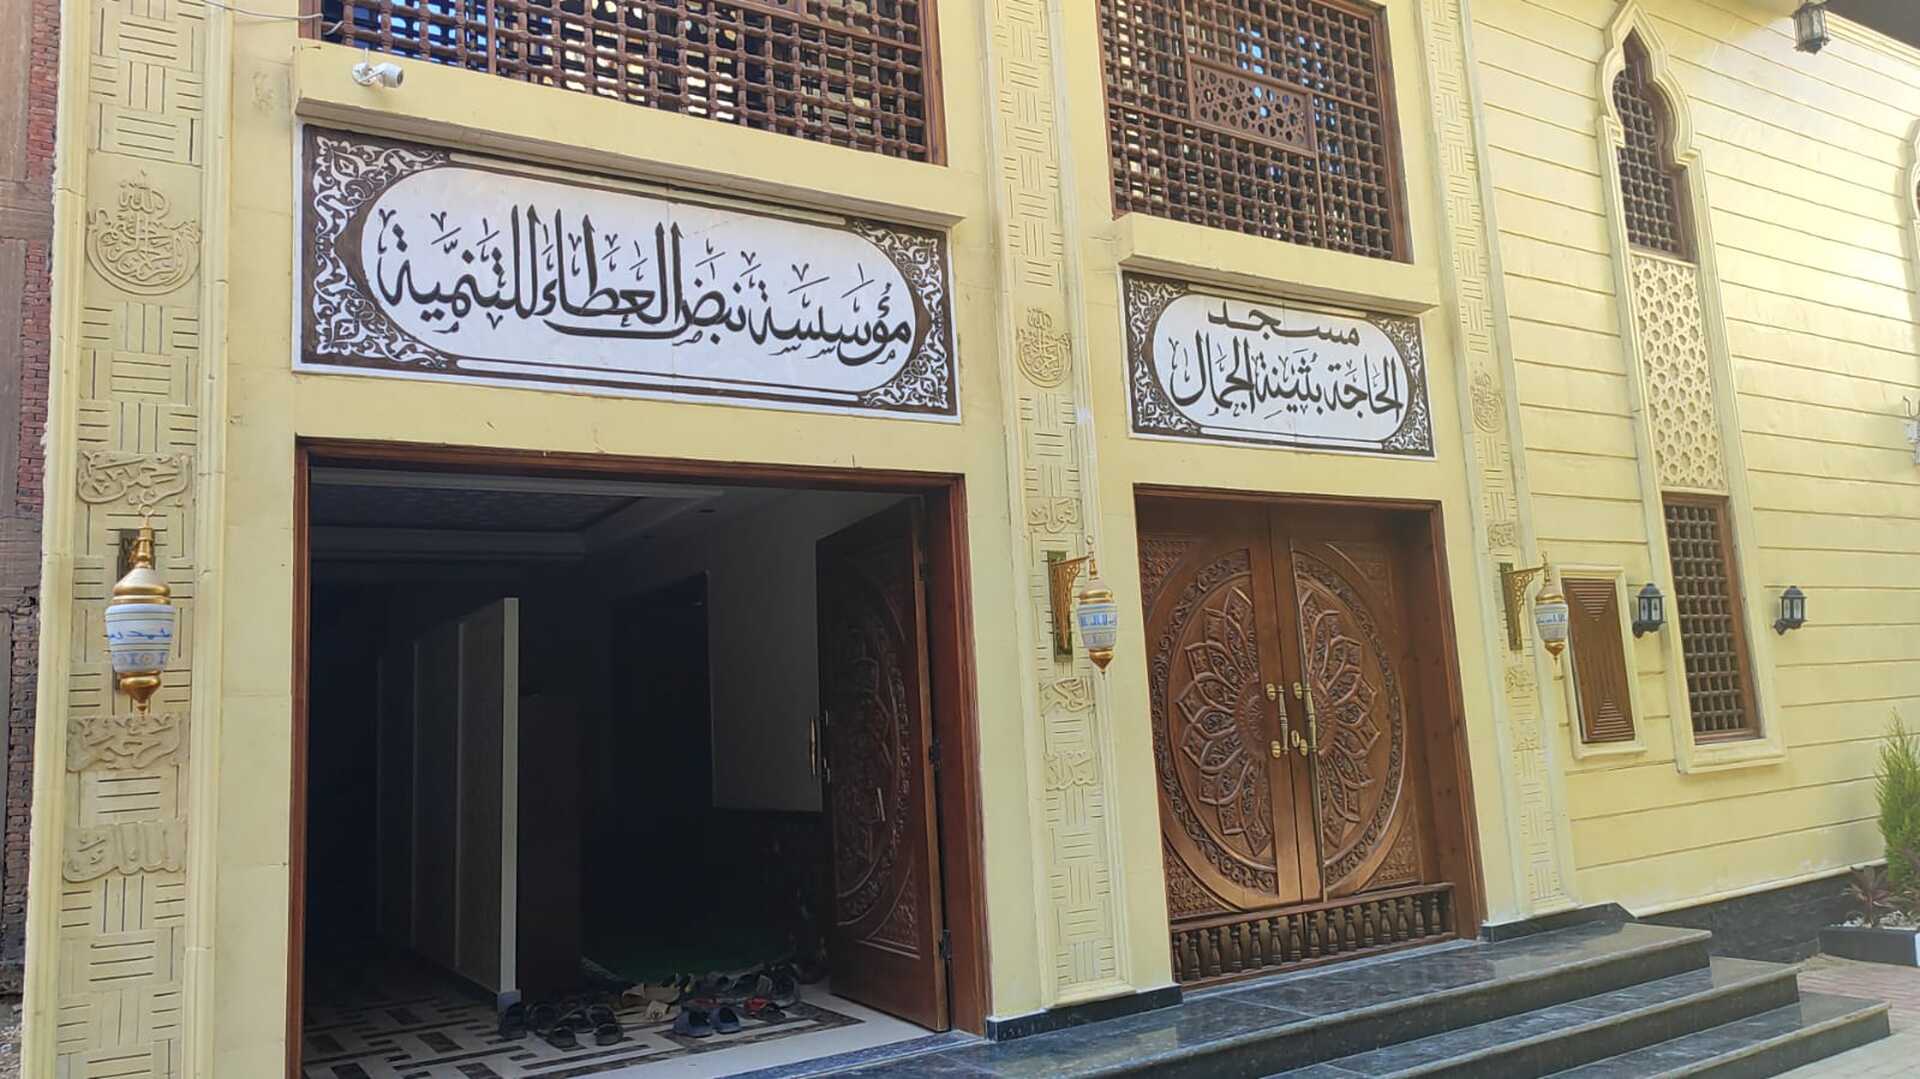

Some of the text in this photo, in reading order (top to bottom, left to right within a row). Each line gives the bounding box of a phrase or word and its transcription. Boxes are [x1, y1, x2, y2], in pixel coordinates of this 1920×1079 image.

[376, 204, 542, 333] للتنمية
[533, 208, 685, 327] العطاء
[747, 262, 912, 366] مؤسسة
[1207, 301, 1360, 347] مسجد
[1169, 329, 1256, 418] الجمال
[1252, 349, 1323, 418] بثينة
[1322, 353, 1404, 422] الحاجة
